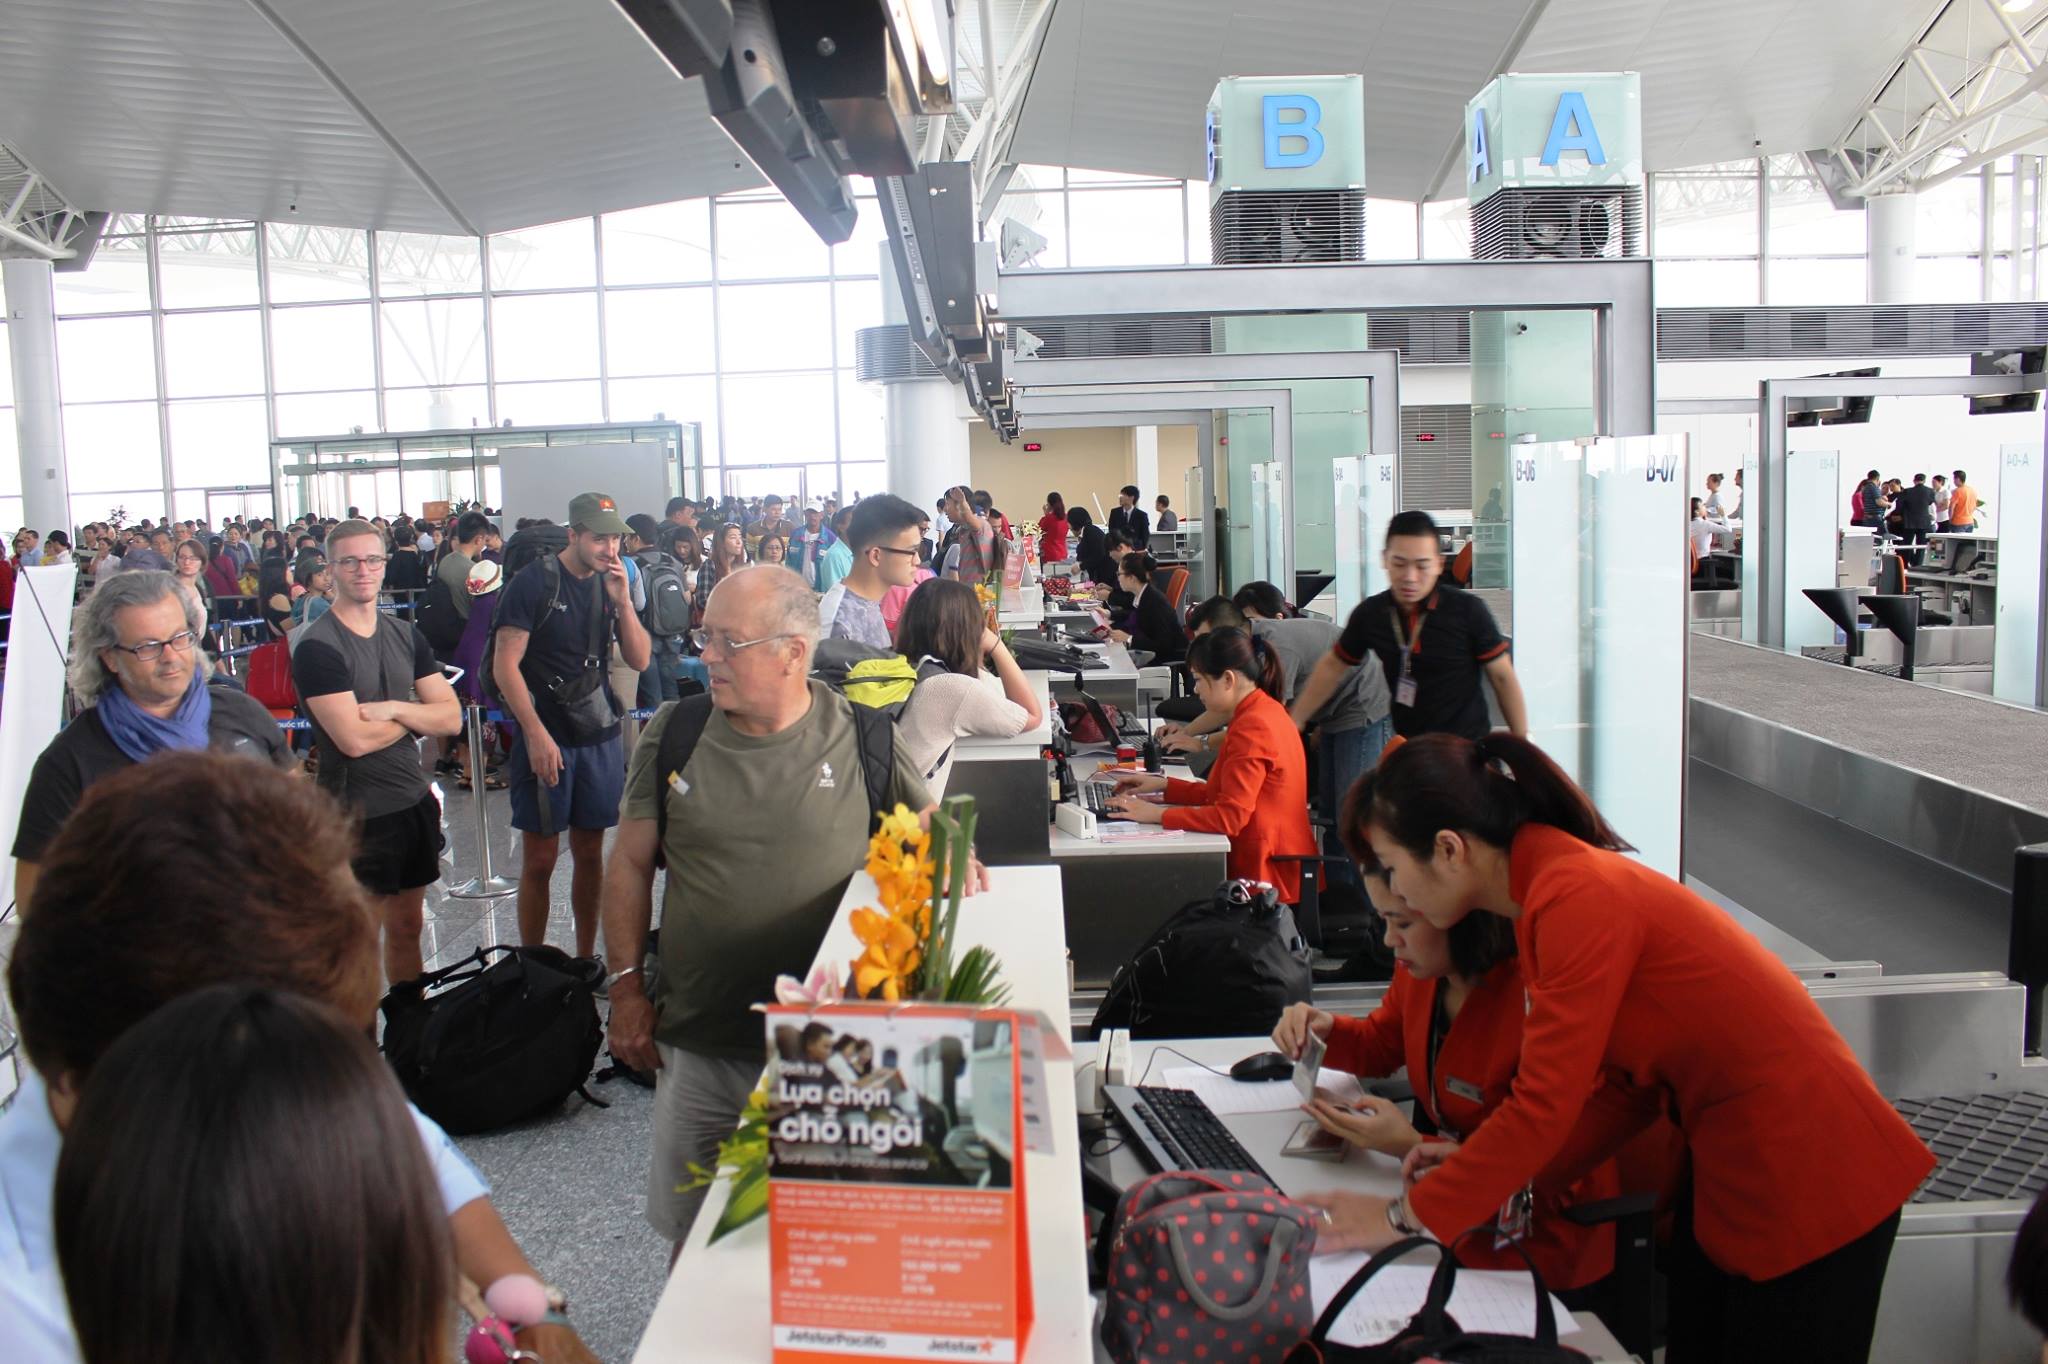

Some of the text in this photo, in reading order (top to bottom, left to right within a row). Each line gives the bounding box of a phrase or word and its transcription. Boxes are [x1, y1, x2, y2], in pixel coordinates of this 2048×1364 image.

[1262, 94, 1325, 169] B
[1471, 108, 1491, 184] A
[1540, 92, 1606, 167] A
[1516, 459, 1535, 482] B-06
[1646, 454, 1678, 483] B-07
[778, 1078, 891, 1112] Lựa chọn
[778, 1105, 923, 1154] chỗ ngồi
[928, 1339, 979, 1354] Jetstar
